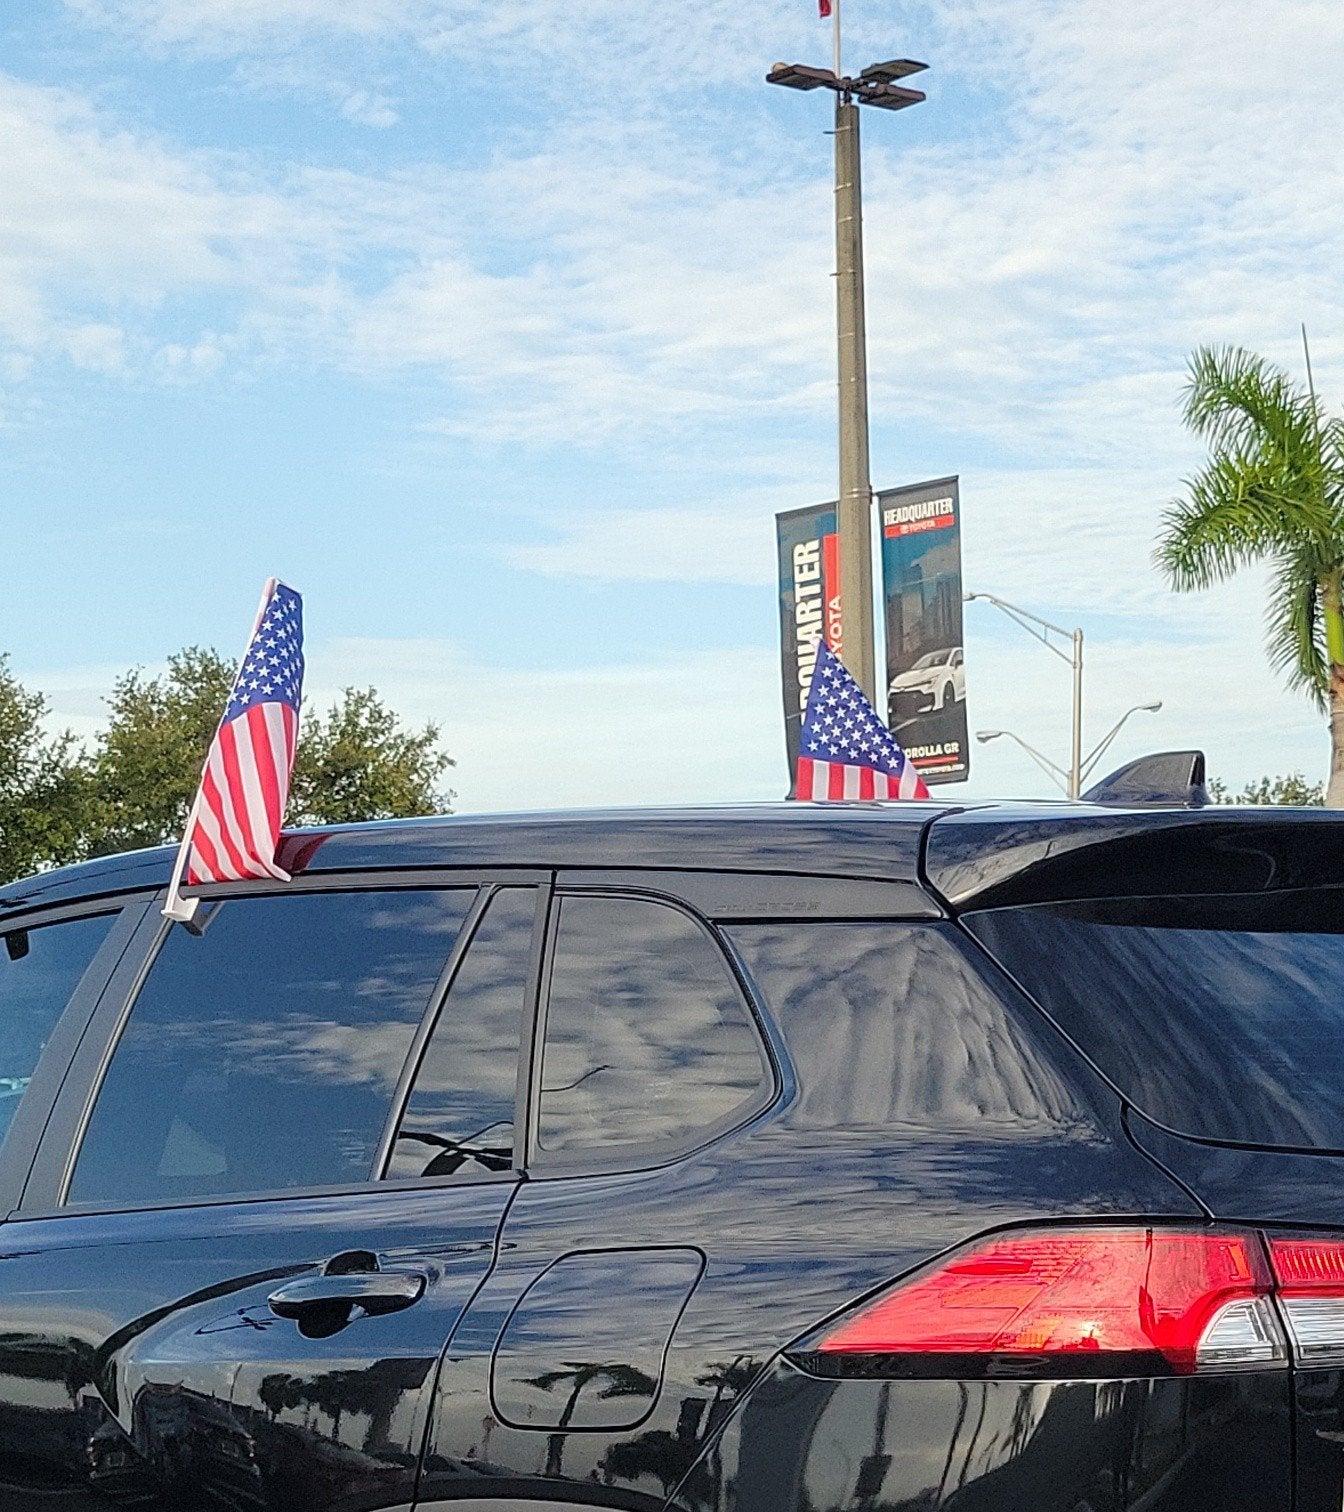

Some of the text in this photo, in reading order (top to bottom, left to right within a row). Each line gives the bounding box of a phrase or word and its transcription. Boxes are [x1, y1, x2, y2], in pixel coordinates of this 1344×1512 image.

[884, 497, 953, 526] HEADQUARTER
[828, 595, 843, 662] YOTA
[904, 742, 960, 759] OROLLA GR
